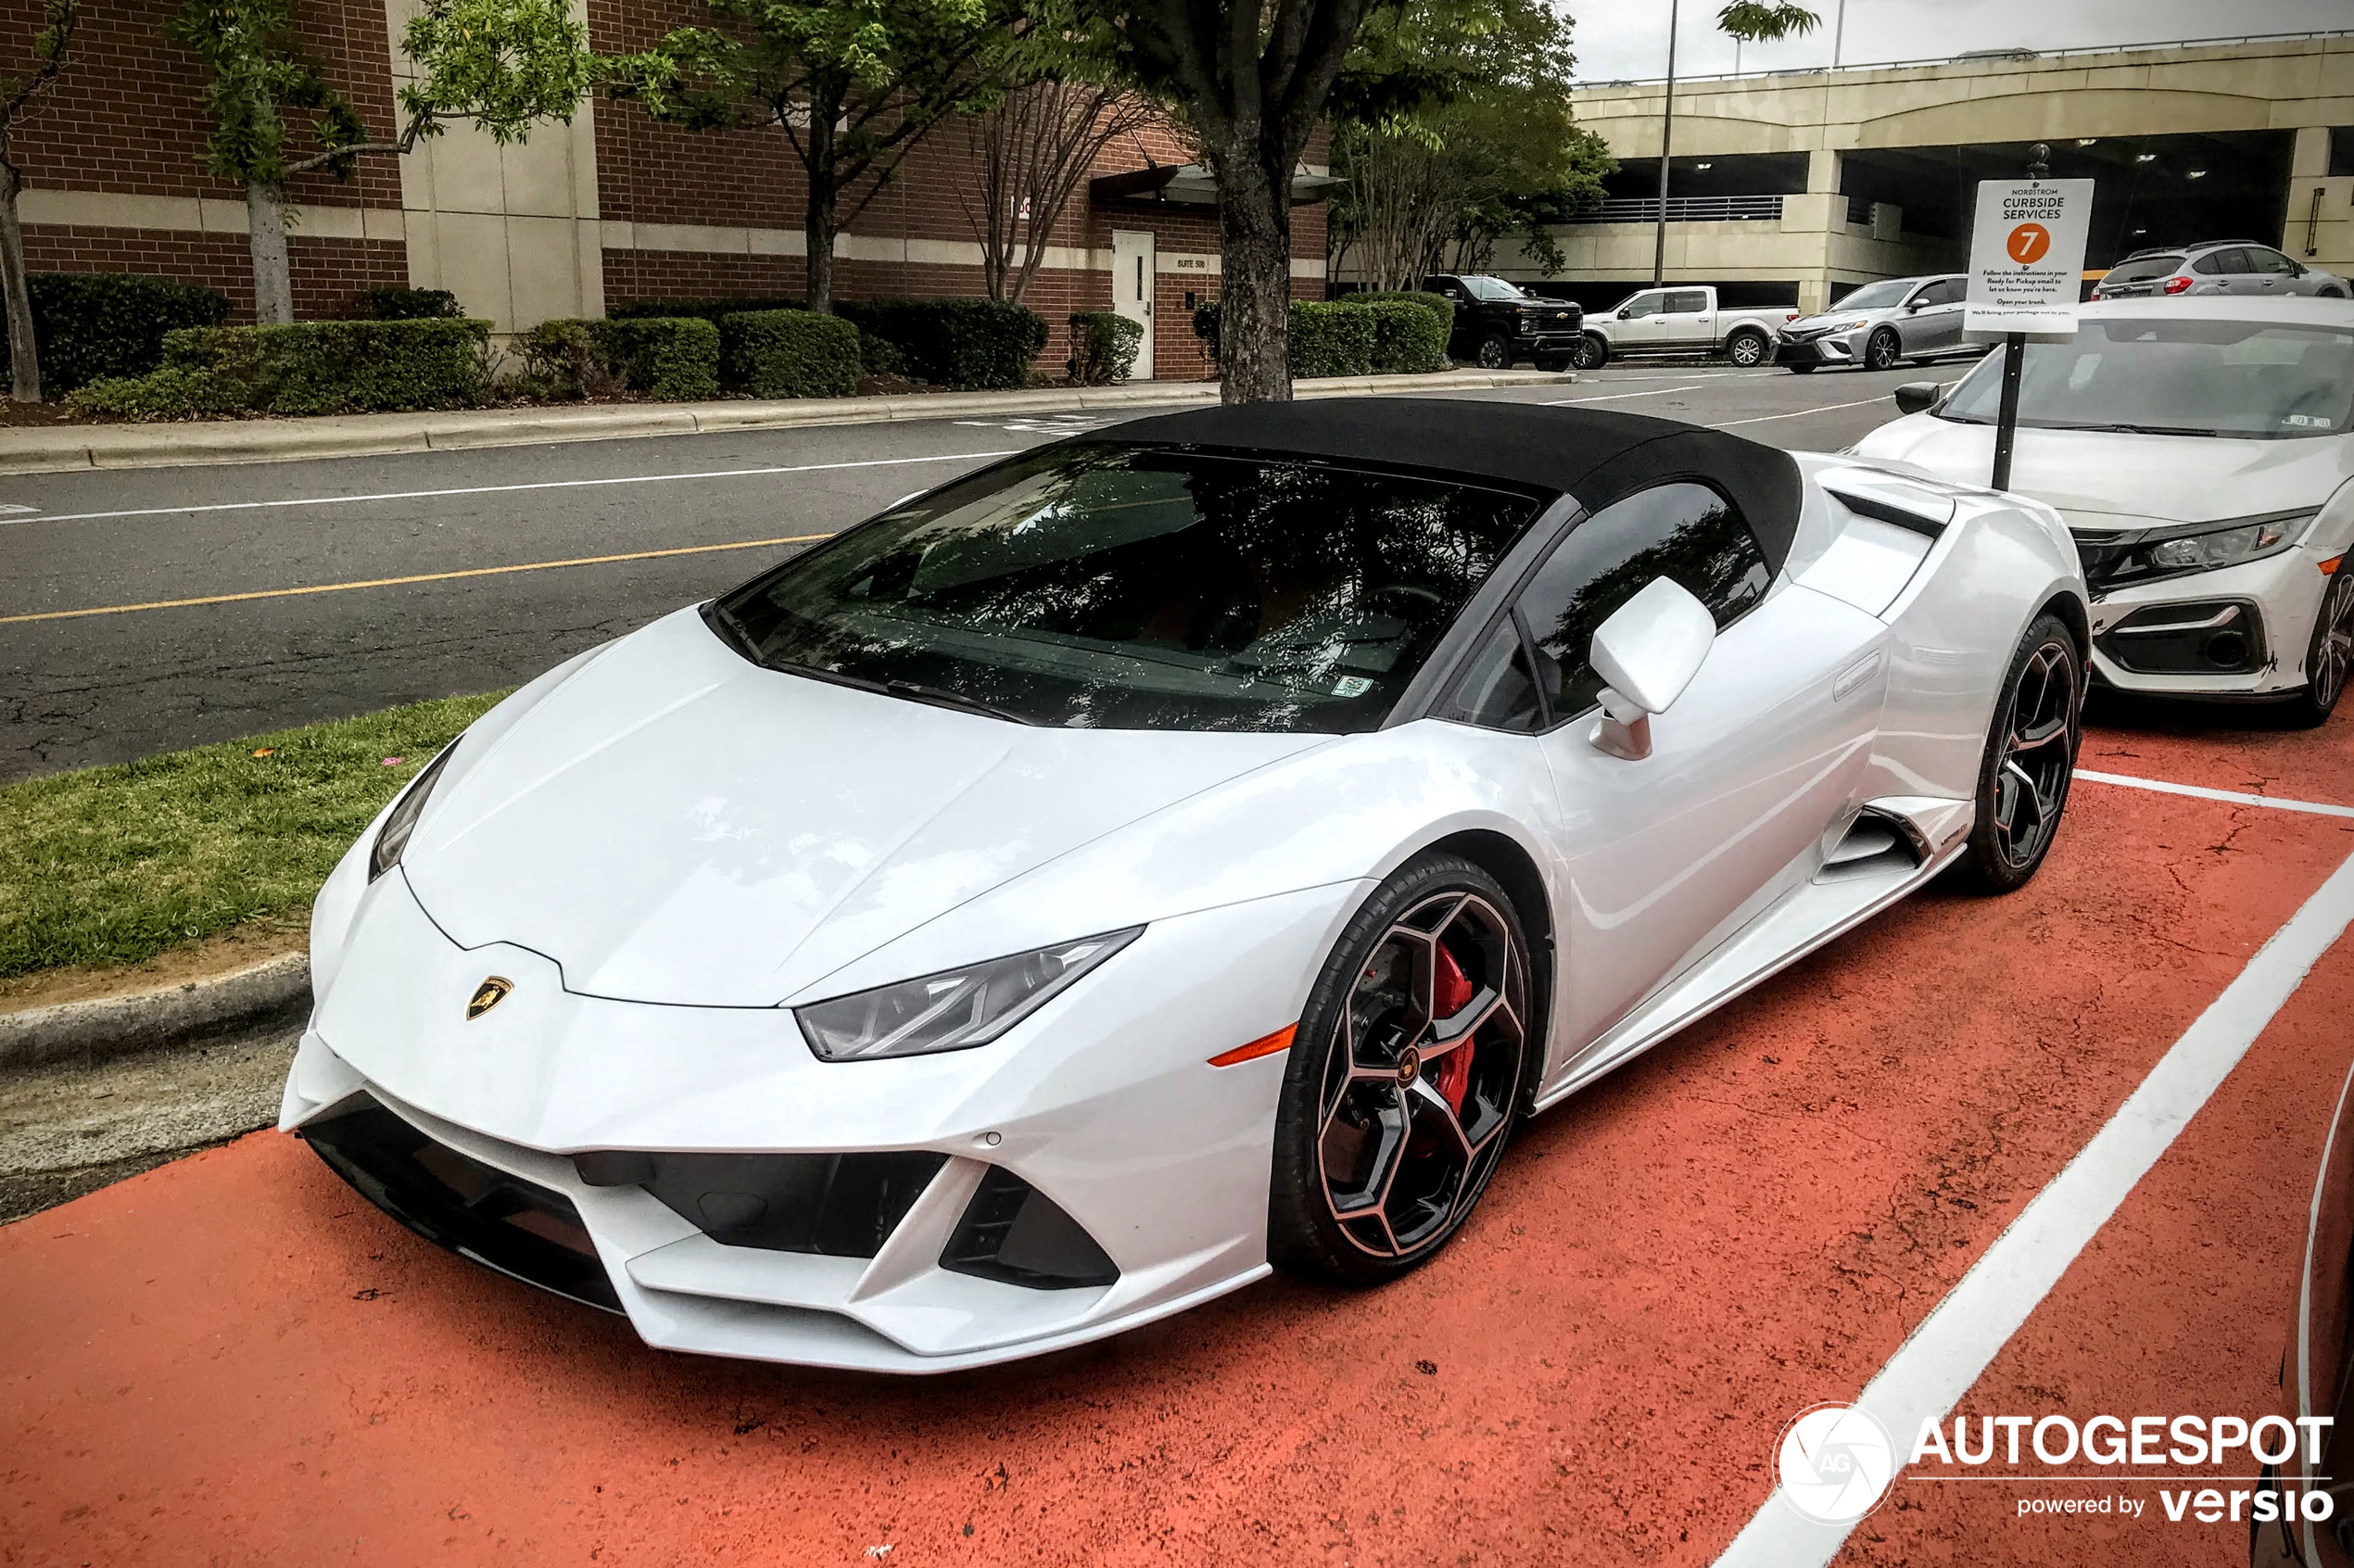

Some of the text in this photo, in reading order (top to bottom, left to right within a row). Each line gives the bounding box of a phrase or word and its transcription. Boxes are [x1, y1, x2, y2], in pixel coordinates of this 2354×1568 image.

[2003, 197, 2065, 208] CURBSIDE
[2003, 209, 2061, 220] SERVICES
[2019, 232, 2039, 257] 7
[1177, 259, 1194, 268] SUITE
